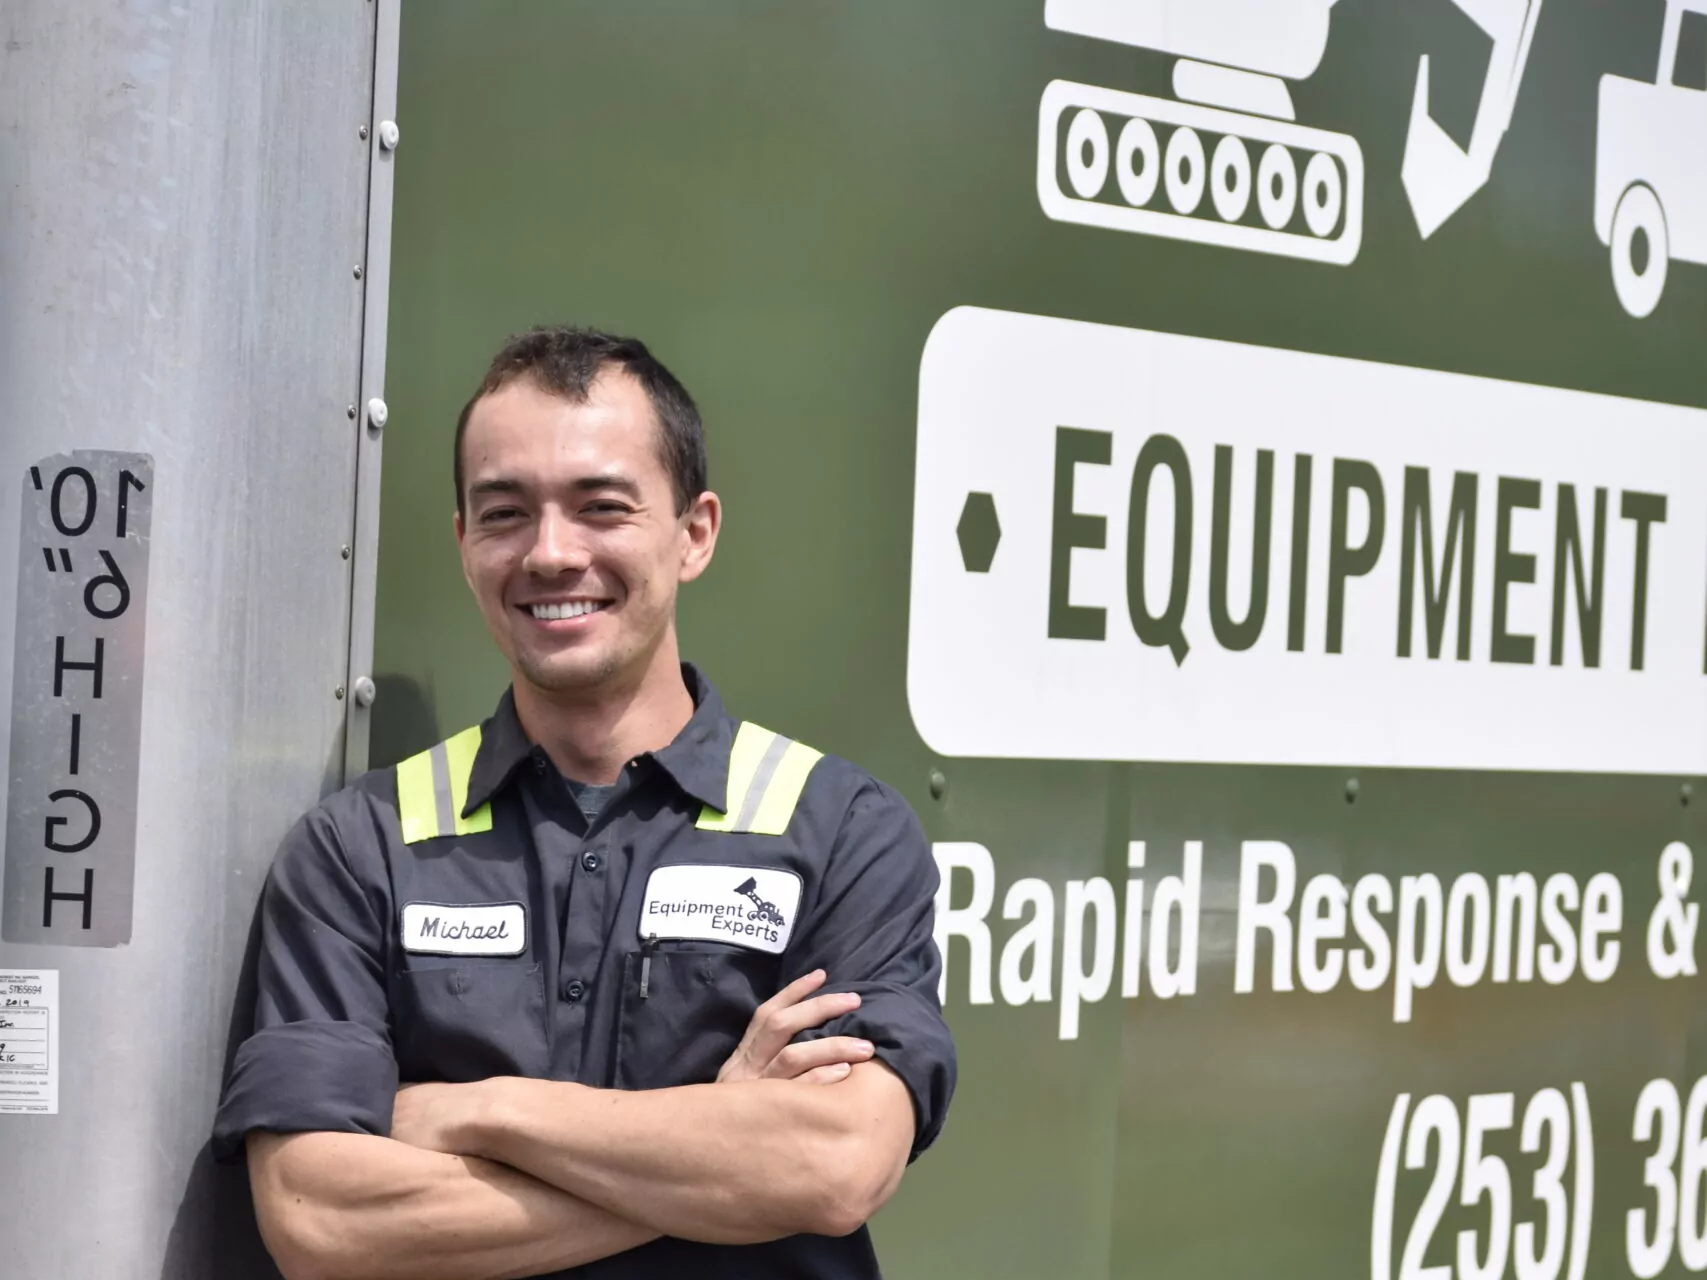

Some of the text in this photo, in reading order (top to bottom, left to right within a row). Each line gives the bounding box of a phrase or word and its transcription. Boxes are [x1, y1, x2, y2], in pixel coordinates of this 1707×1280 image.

[1048, 427, 1667, 670] EQUIPMENT
[649, 900, 744, 918] Equipment
[420, 916, 509, 940] Michael
[711, 915, 779, 943] Experts
[932, 841, 1698, 1040] Rapid Response &
